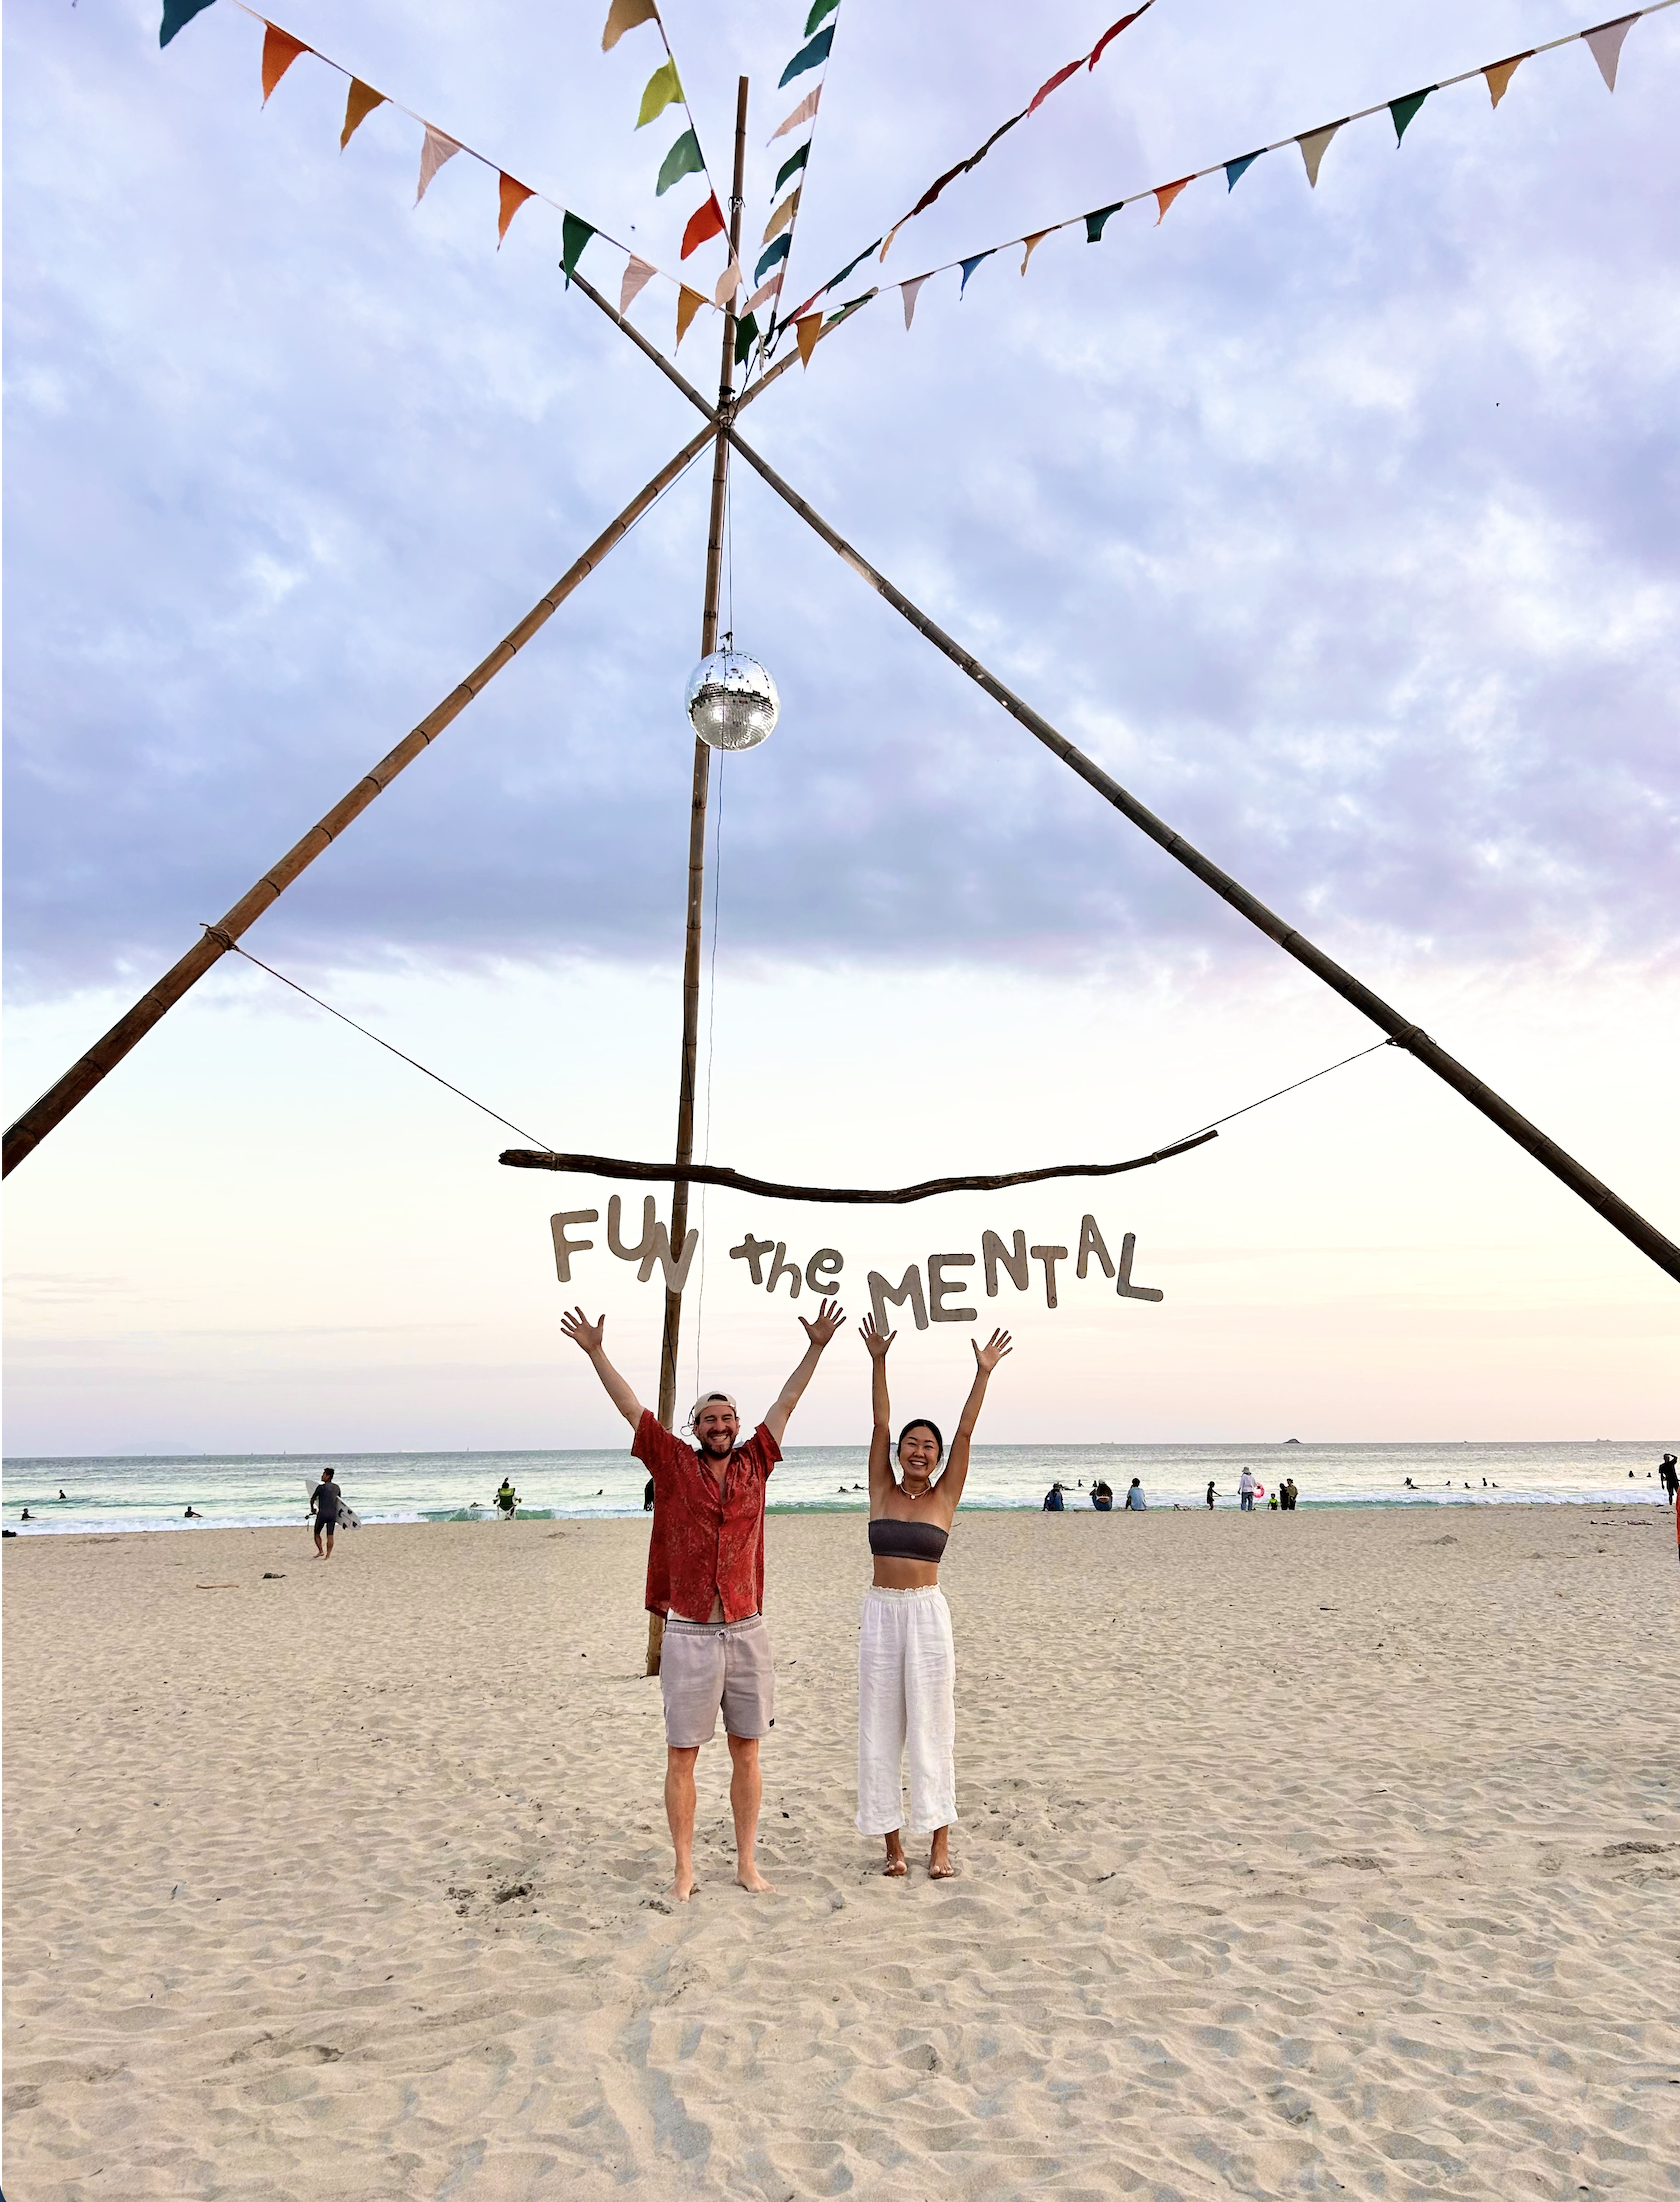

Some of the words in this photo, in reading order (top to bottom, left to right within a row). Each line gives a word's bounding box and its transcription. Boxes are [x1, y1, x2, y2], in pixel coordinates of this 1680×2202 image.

[550, 1194, 699, 1293] FUN
[729, 1232, 844, 1299] the
[867, 1214, 1164, 1337] MENTAL
